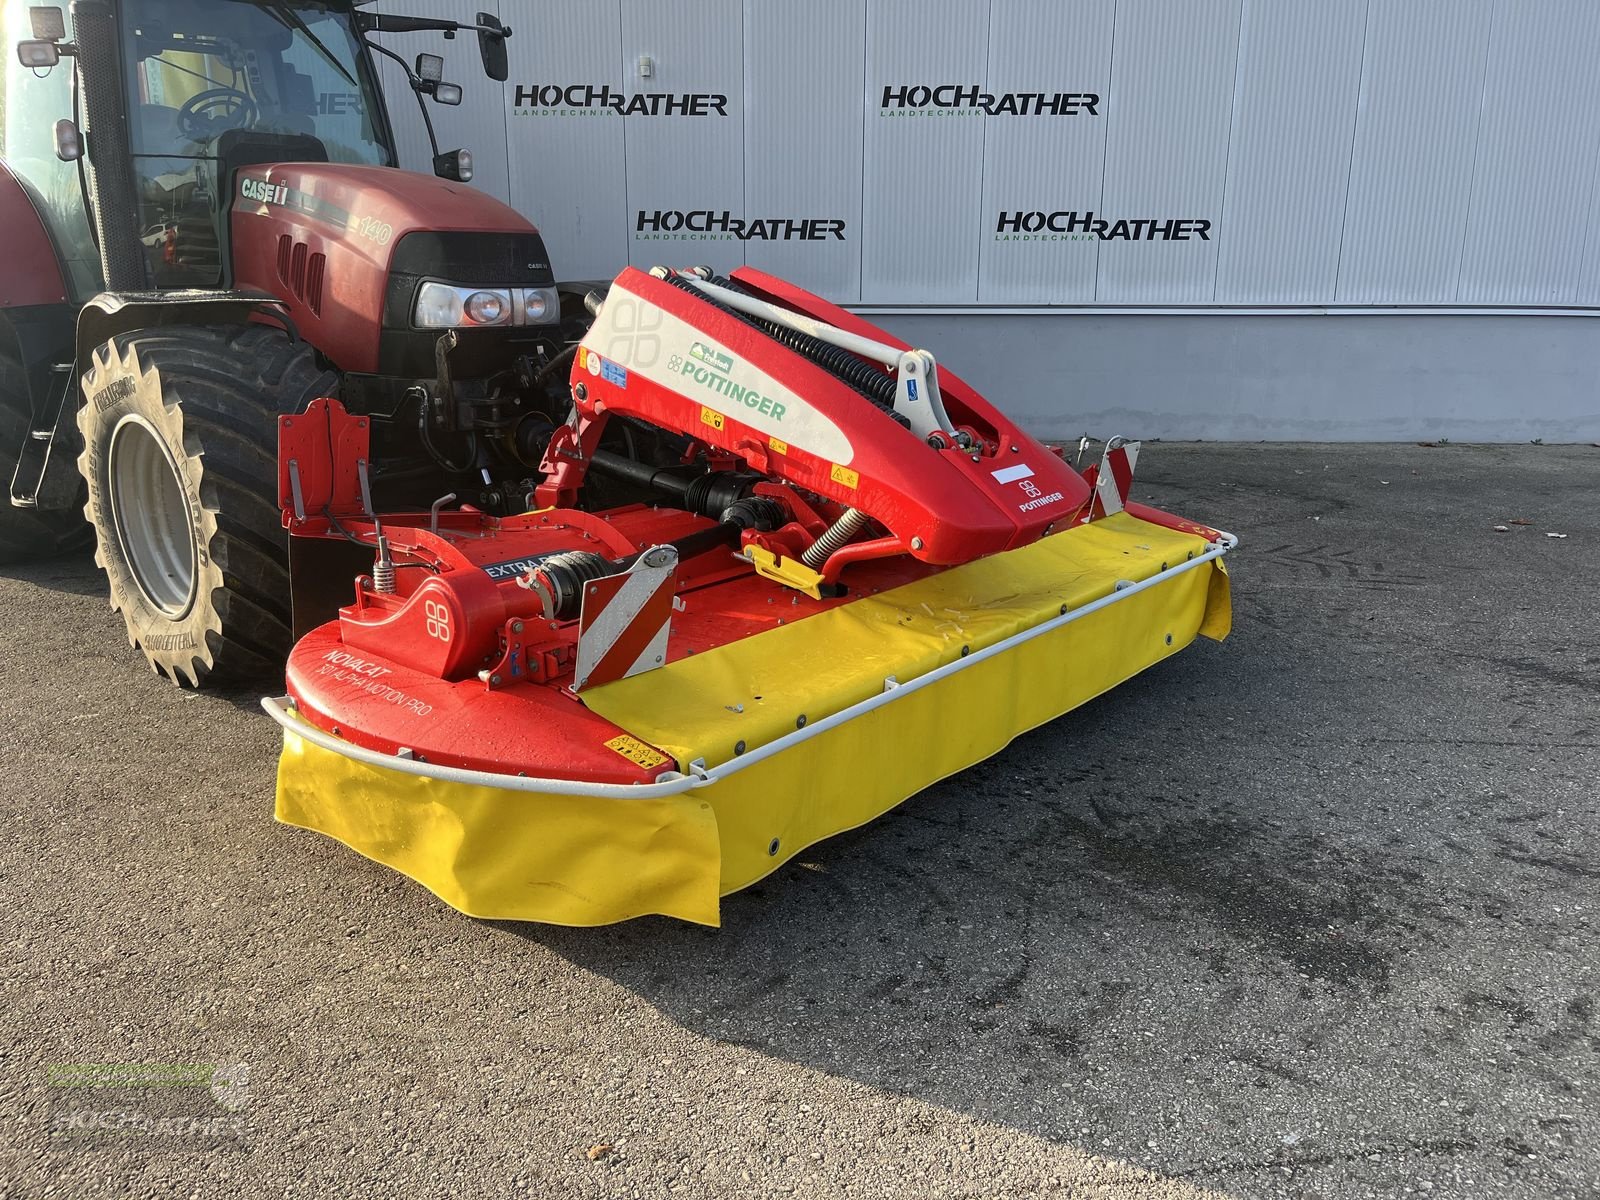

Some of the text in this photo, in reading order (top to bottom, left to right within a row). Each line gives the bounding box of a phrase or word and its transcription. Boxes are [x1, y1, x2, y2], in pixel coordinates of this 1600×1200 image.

[514, 85, 728, 116] HOCHRATHER
[514, 109, 613, 117] LANDTECHNIK
[880, 109, 982, 117] LANDTECHNIK
[881, 85, 1100, 116] HOCHRATHER
[359, 215, 393, 246] 140
[635, 233, 733, 241] LANDTECHNIK
[636, 210, 846, 241] HOCHRATHER
[995, 234, 1095, 242] LANDTECHNIK
[996, 211, 1211, 241] HOCHRATHER
[485, 559, 540, 578] EXTRA
[321, 650, 393, 678] NOVACAT
[316, 664, 433, 716] 301 ALPHA MOTION PRO
